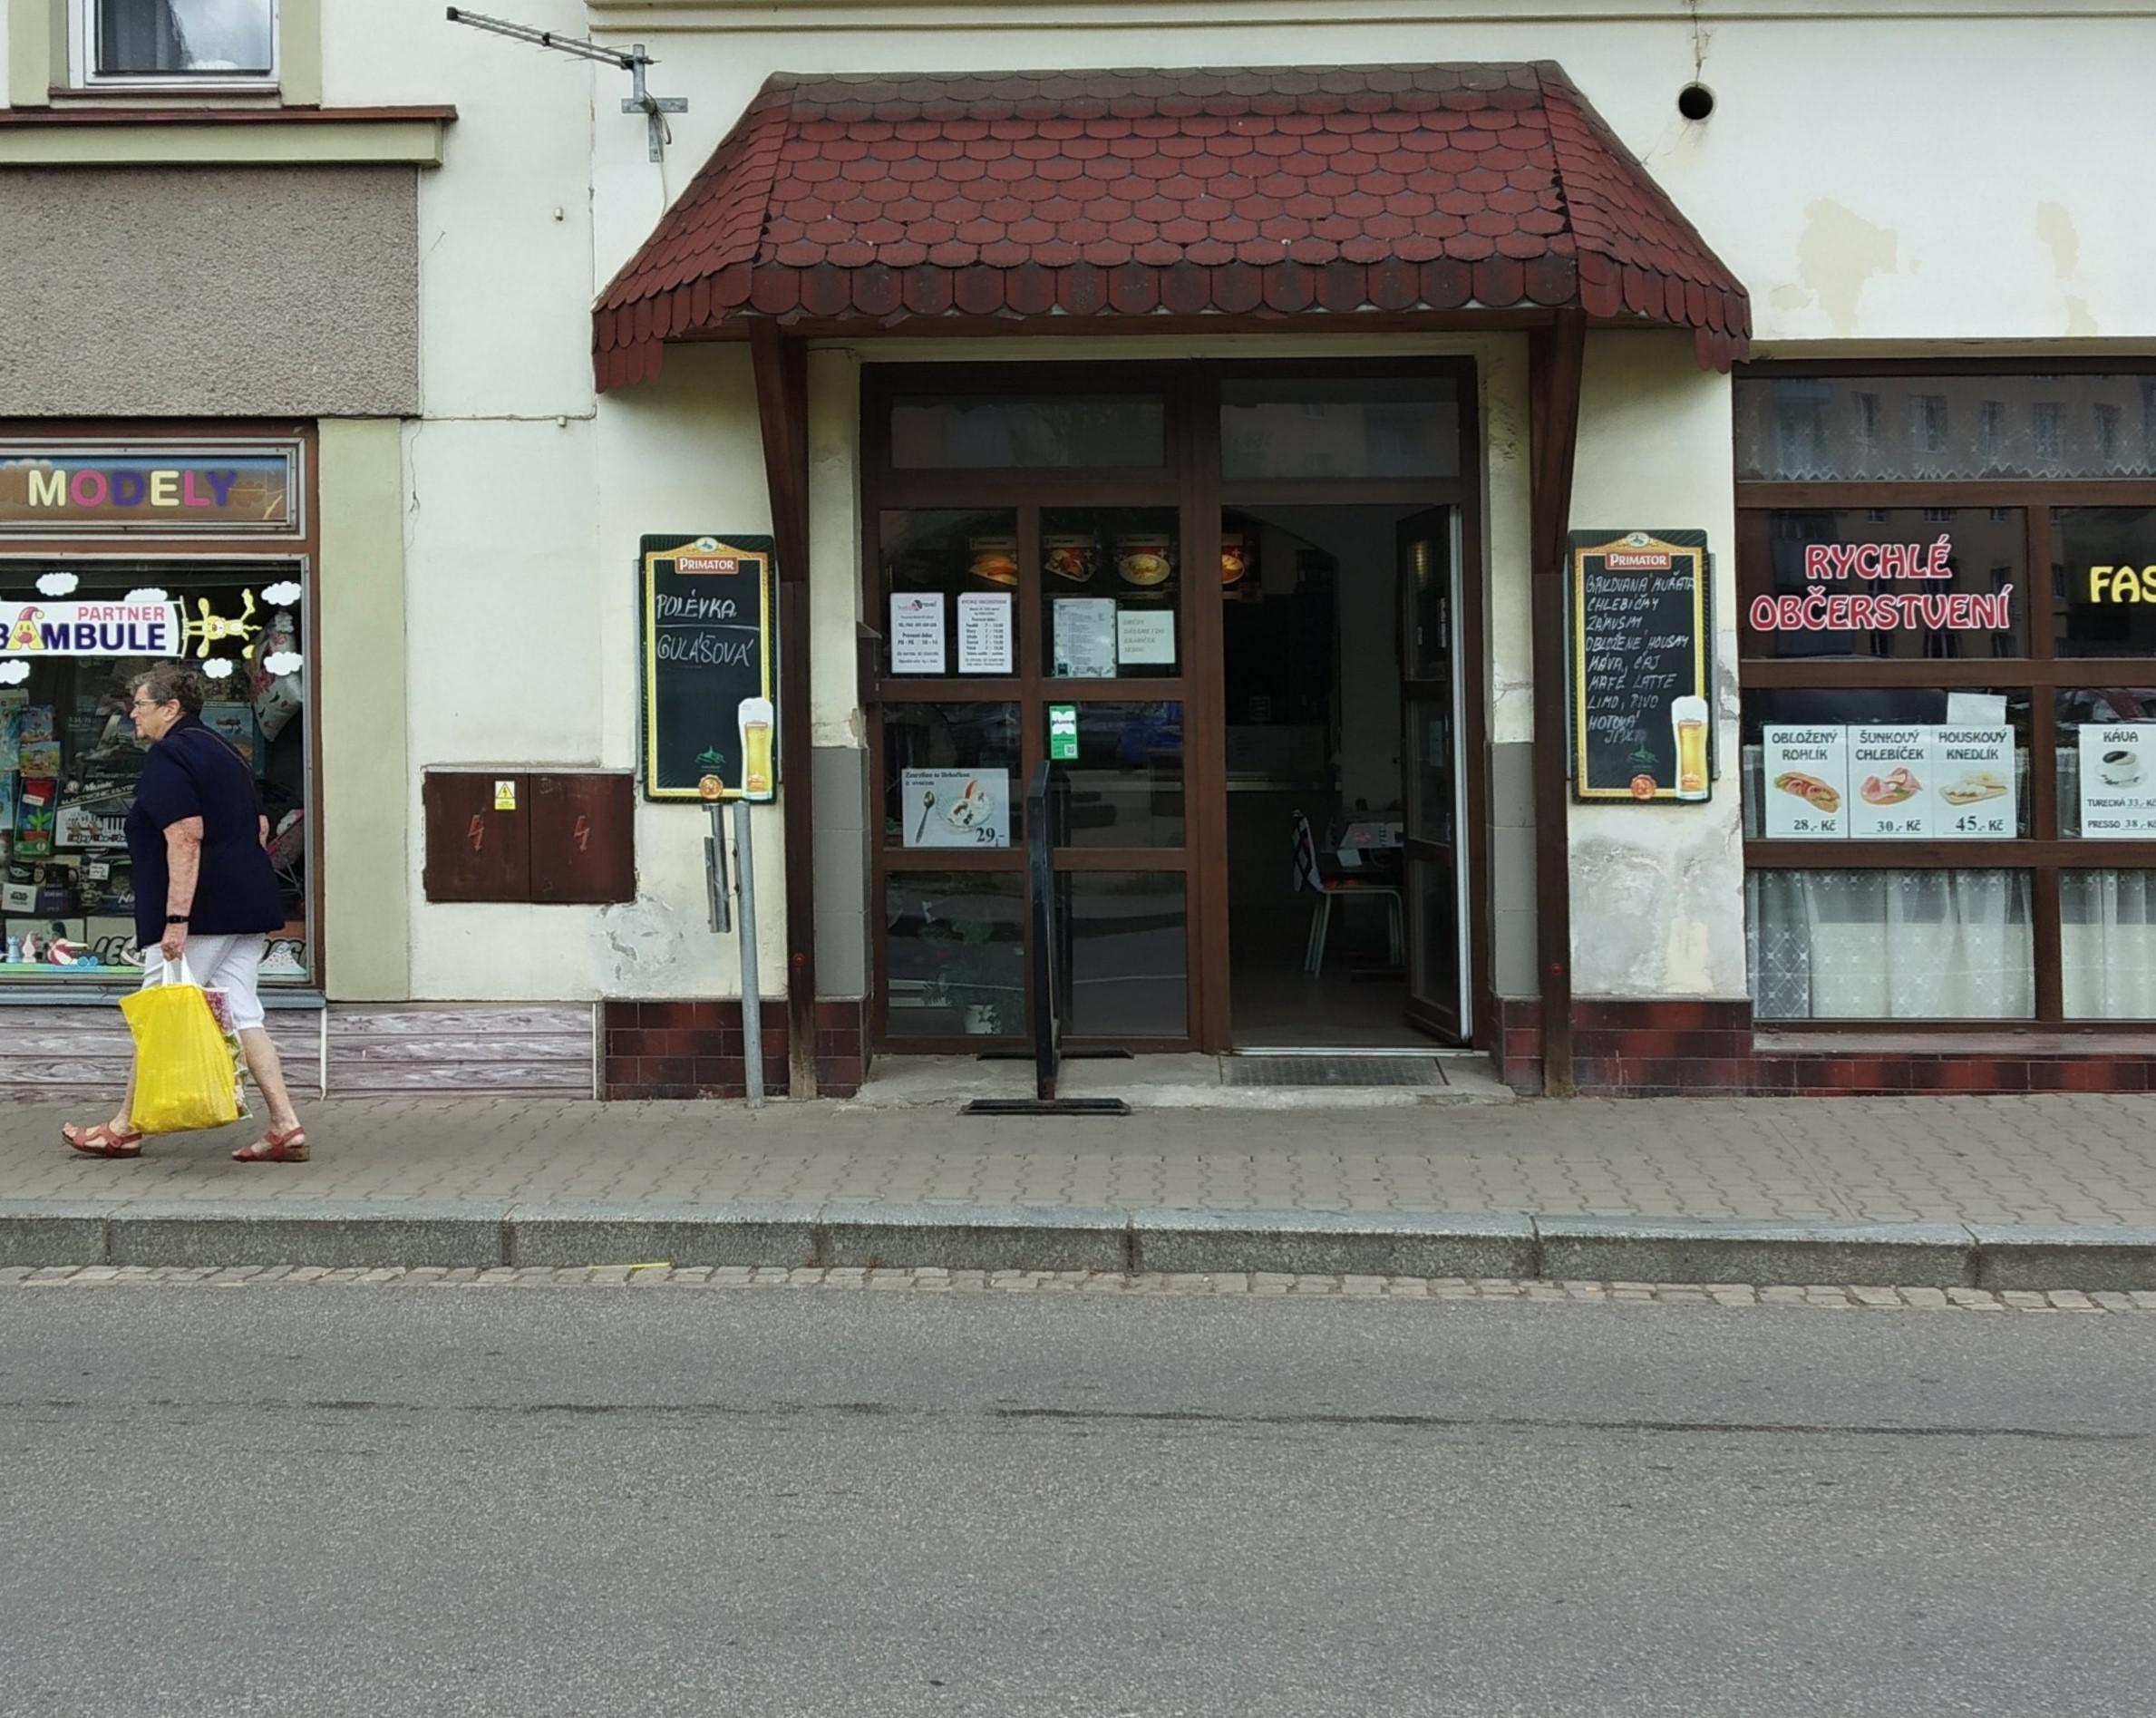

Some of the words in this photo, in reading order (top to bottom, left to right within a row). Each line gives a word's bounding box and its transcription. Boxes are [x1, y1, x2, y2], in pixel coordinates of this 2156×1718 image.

[28, 470, 237, 508] MODELY
[1805, 533, 1953, 579] RYCHLÉ
[77, 607, 165, 621] PARTNER
[1749, 584, 2014, 631] OBČERSTVENÍ
[657, 631, 754, 667] GULÁŠOVÁ
[1632, 673, 1677, 690] LATTE
[1772, 729, 1839, 744] OBLOŽENÝ
[1860, 729, 1920, 744] ŠUNKOVÝ
[1938, 728, 2007, 743] HOUSKOVÝ
[2103, 728, 2139, 743] KÁVA
[1782, 745, 1829, 761] ROHLÍK
[1855, 745, 1924, 761] CHLEBÍČEK
[1947, 745, 1999, 761] KNEDLÍK
[1821, 820, 1836, 831] Kč
[1906, 820, 1921, 831] Kč
[1988, 820, 2004, 831] Kč
[2087, 820, 2121, 829] PRESSO
